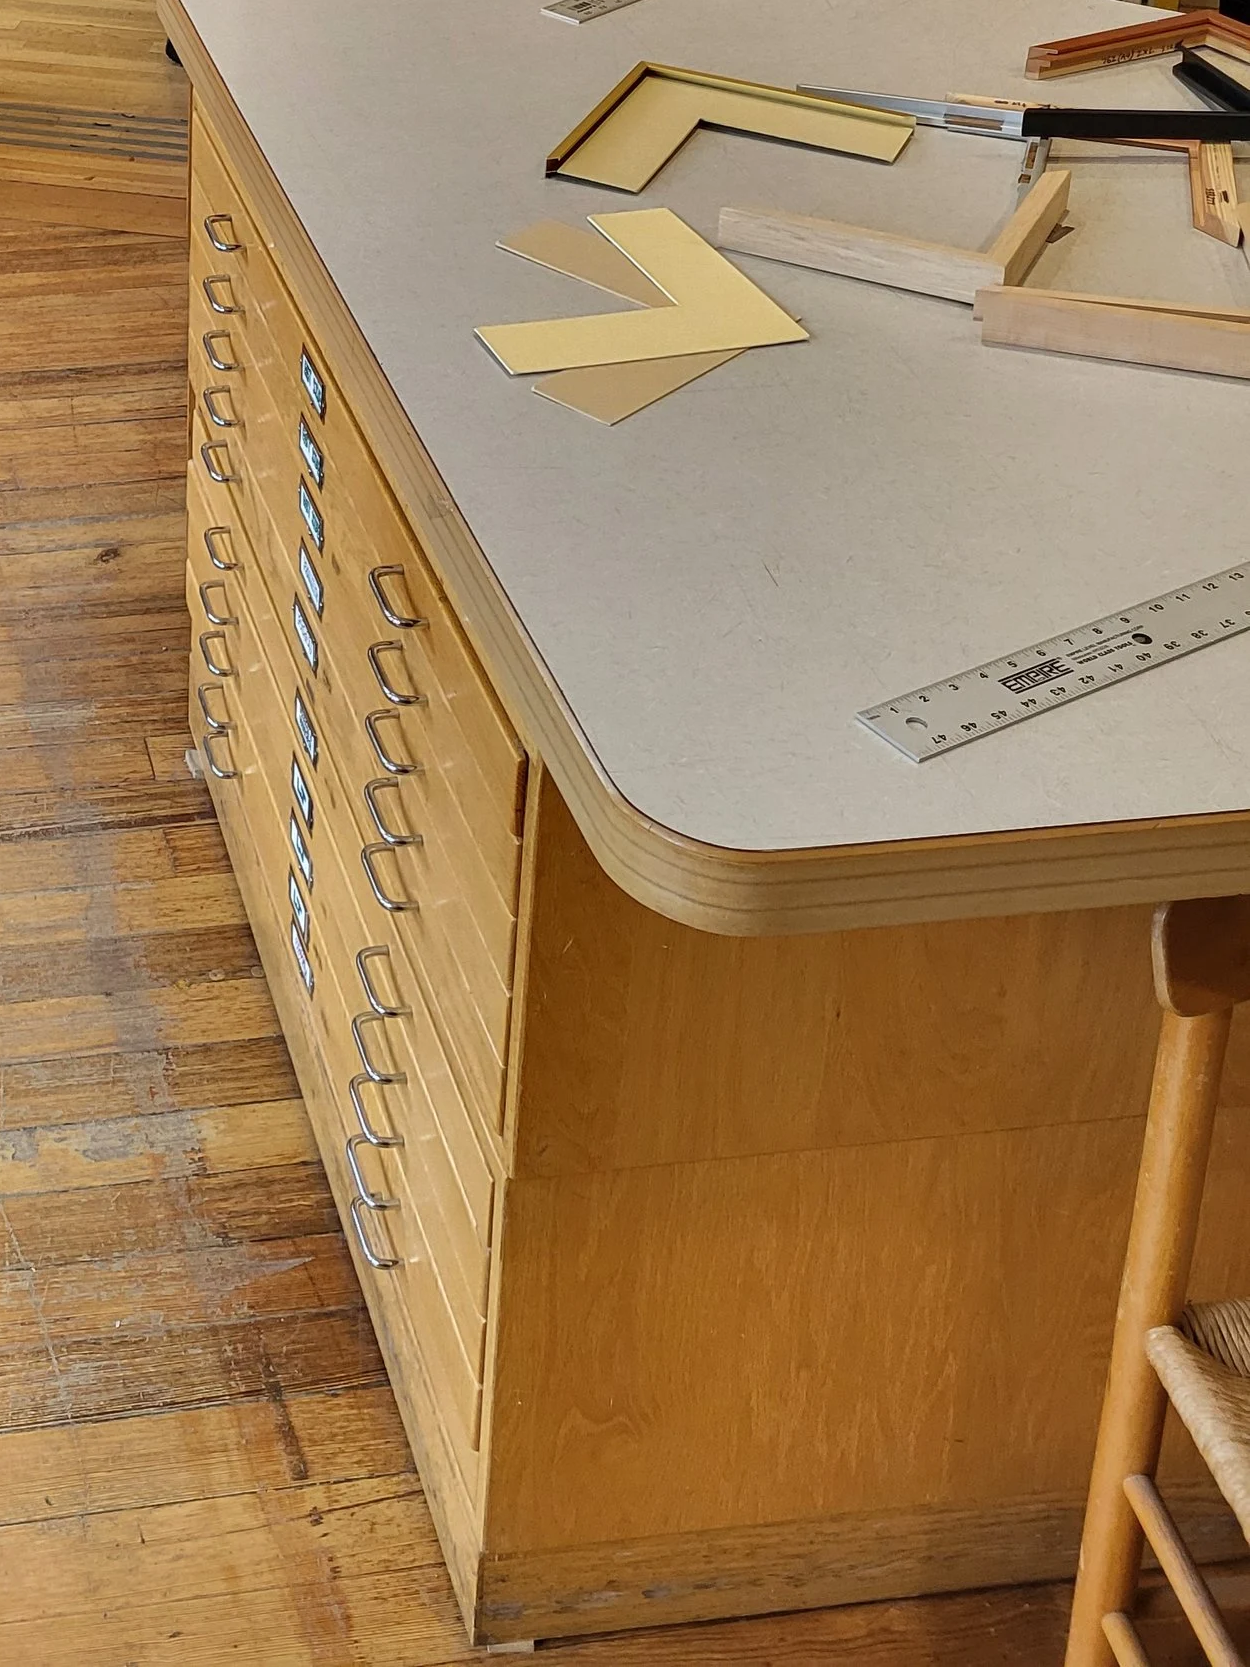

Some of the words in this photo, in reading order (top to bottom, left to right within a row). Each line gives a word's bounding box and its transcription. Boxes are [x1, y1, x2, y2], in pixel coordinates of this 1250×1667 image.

[889, 705, 900, 714] 1
[918, 694, 930, 704] 2
[948, 682, 959, 691] 3
[978, 671, 989, 680] 4
[1006, 659, 1018, 669] 5
[1035, 648, 1047, 658] 6
[1062, 638, 1074, 647] 7
[1092, 627, 1103, 636] 8
[1119, 616, 1131, 624] 9
[1148, 602, 1165, 614] 10
[1175, 592, 1191, 603] 11
[1202, 581, 1219, 592] 12
[1228, 571, 1244, 582] 13
[931, 732, 948, 745] 47
[960, 721, 977, 733] 46
[990, 709, 1007, 721] 45
[1020, 697, 1038, 709] 44
[1050, 685, 1066, 697] 43
[1078, 674, 1095, 685] 42
[1107, 663, 1124, 674] 41
[1135, 651, 1152, 662] 40
[1163, 640, 1181, 651] 39
[1191, 629, 1209, 640] 38
[1219, 618, 1235, 630] 37
[1000, 659, 1073, 693] EMPIRE
